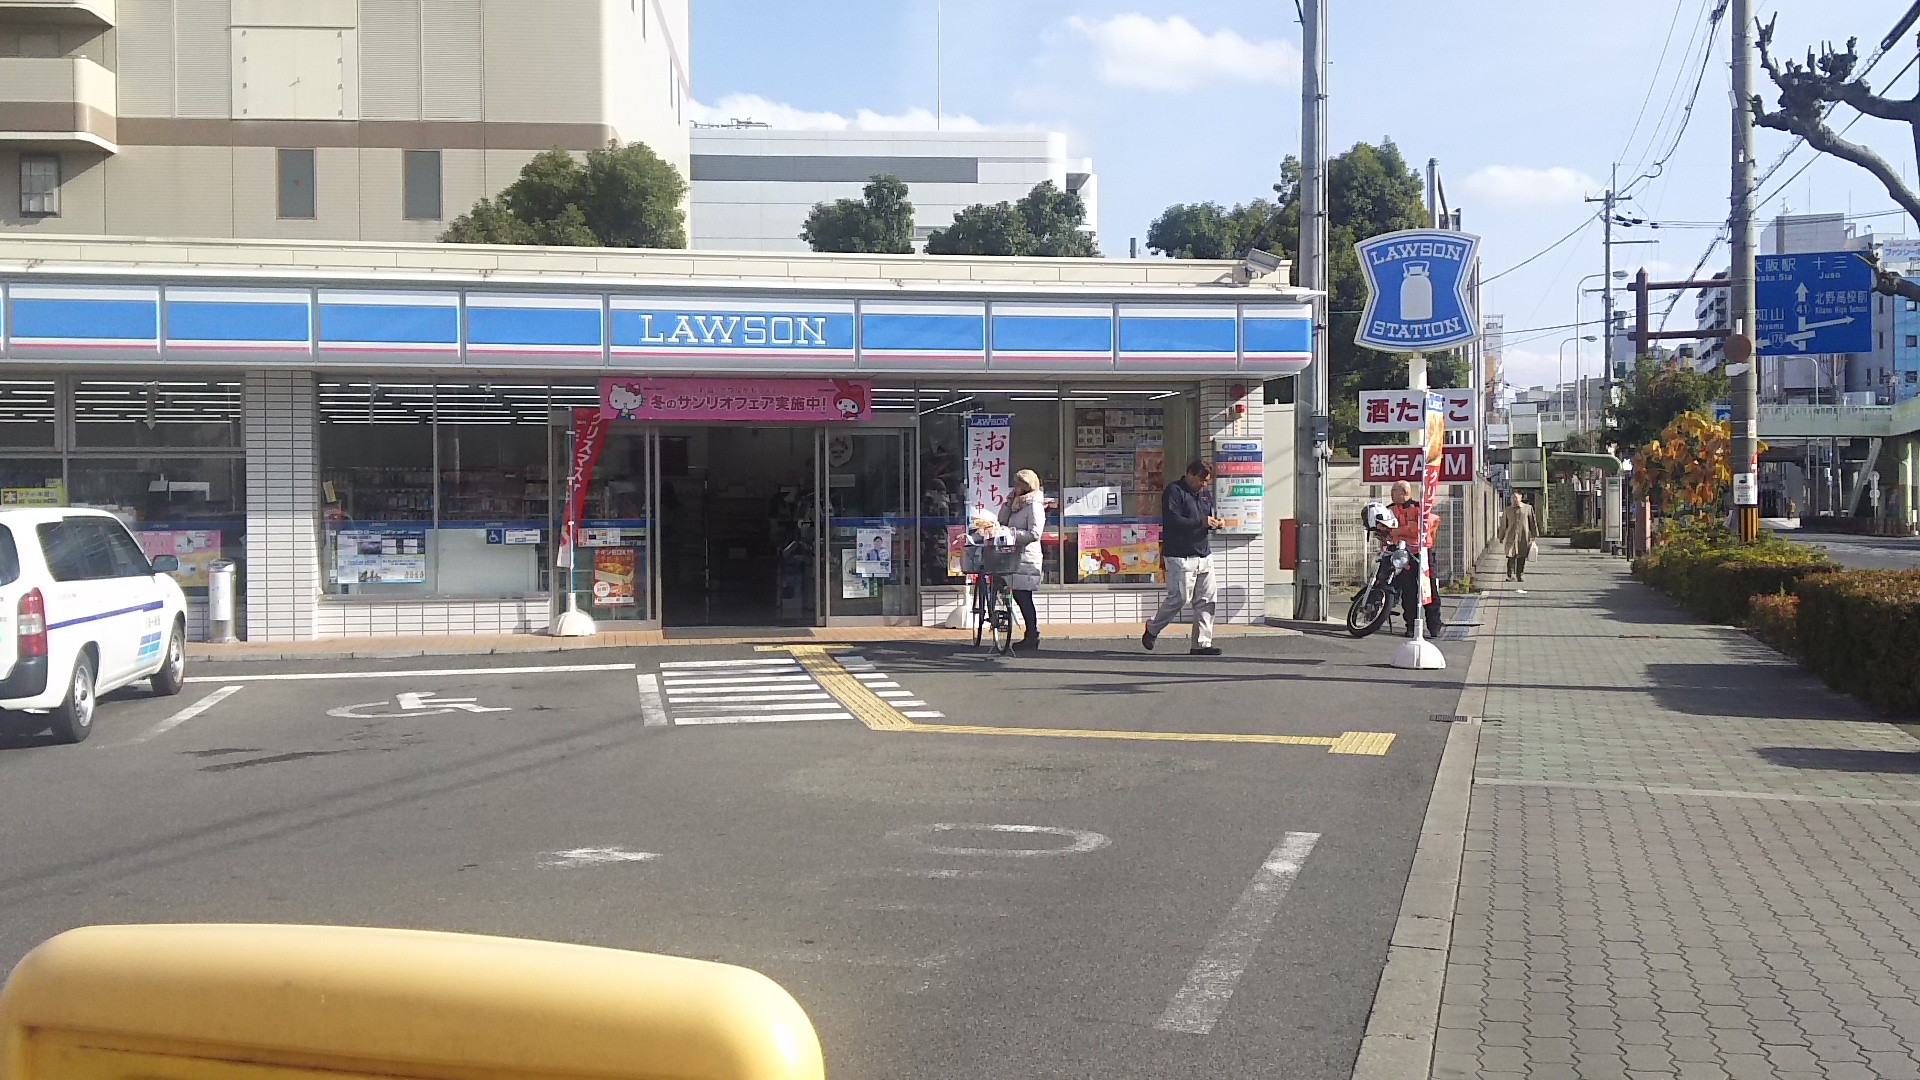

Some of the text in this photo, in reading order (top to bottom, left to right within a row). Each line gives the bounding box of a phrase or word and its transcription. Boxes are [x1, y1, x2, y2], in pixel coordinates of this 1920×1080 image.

[1370, 242, 1463, 266] LAWSON
[1812, 256, 1847, 270] 十三
[1755, 274, 1776, 282] saka
[1755, 307, 1785, 321] 知山
[1796, 304, 1808, 314] 41
[639, 314, 827, 345] LAWSON
[1371, 317, 1461, 339] STATION
[1771, 333, 1783, 344] 176
[970, 416, 1009, 426] LAWSON
[1366, 397, 1470, 424] 酒・たこ
[971, 431, 985, 515] ご予約承り中
[984, 430, 1008, 508] おせち
[1369, 453, 1467, 477] 銀行AM
